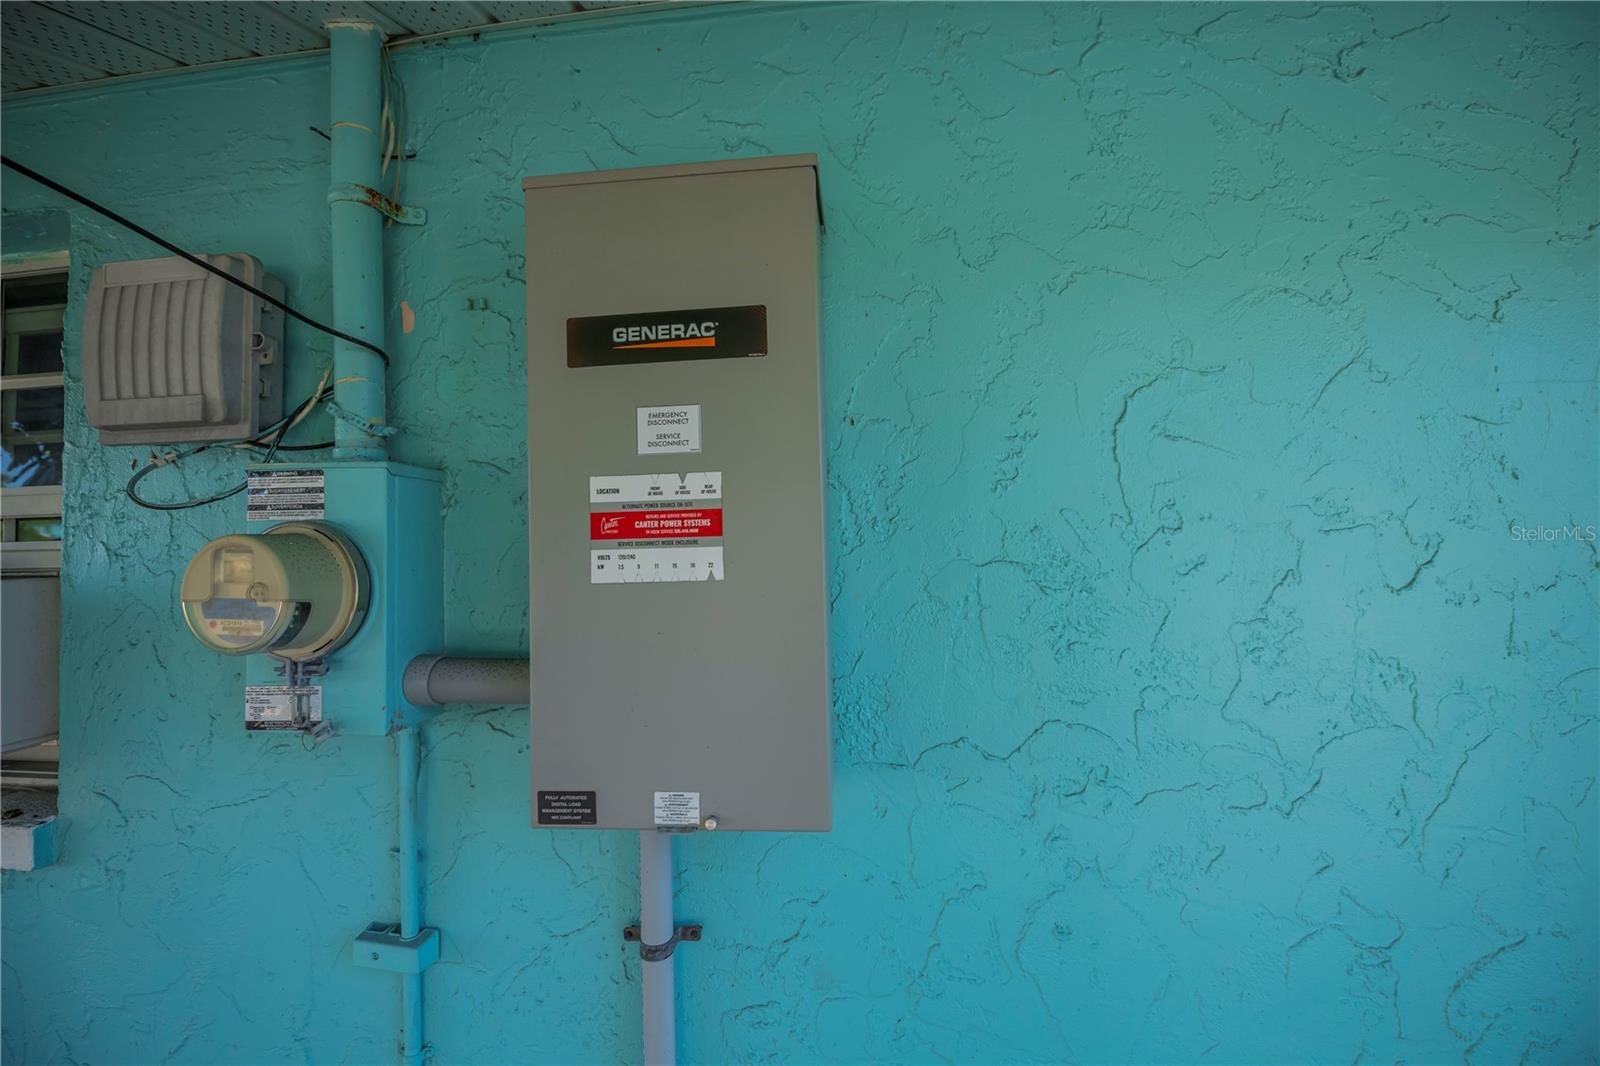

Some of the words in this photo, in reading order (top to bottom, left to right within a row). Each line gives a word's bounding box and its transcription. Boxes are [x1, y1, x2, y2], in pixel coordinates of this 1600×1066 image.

[613, 321, 716, 343] GENERAC
[648, 411, 688, 419] EMERGENCY
[647, 418, 689, 426] DISCONNECT
[656, 432, 681, 440] SERVICE
[634, 520, 659, 529] CANTER
[660, 519, 682, 528] POWER
[683, 518, 711, 527] SYSTEMS
